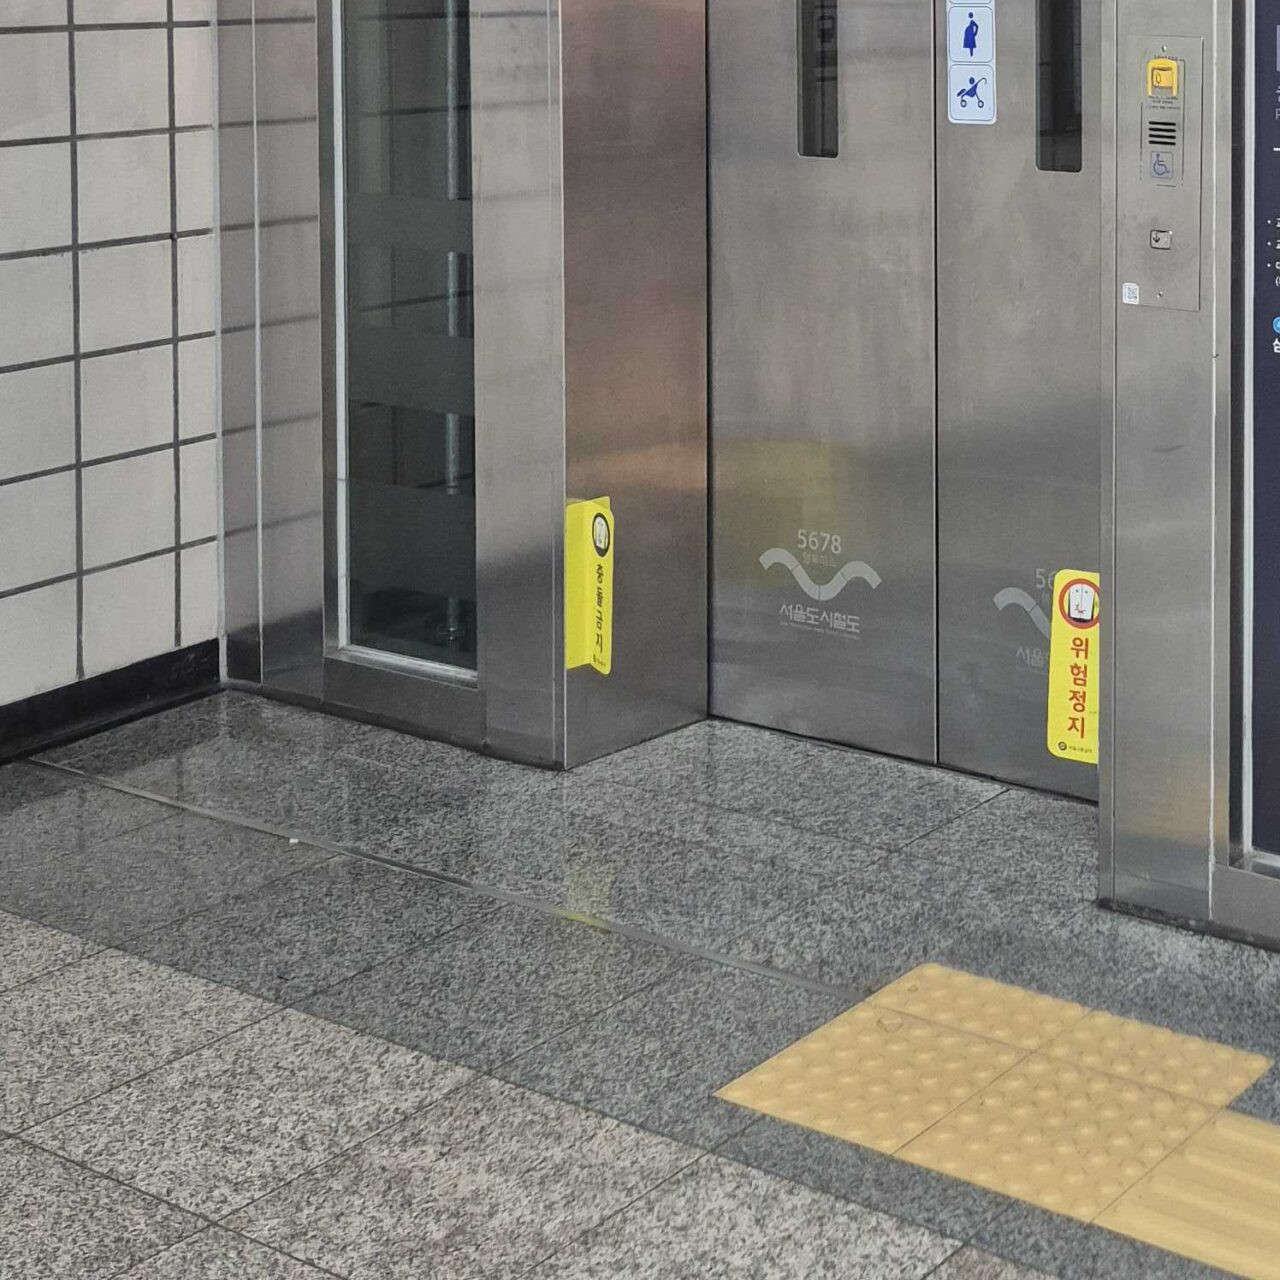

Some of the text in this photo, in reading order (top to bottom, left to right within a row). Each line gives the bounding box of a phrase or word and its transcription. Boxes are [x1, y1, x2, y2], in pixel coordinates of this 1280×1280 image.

[797, 528, 842, 554] 5678
[780, 603, 860, 633] 서울도시철도
[1067, 636, 1090, 739] 위험정지
